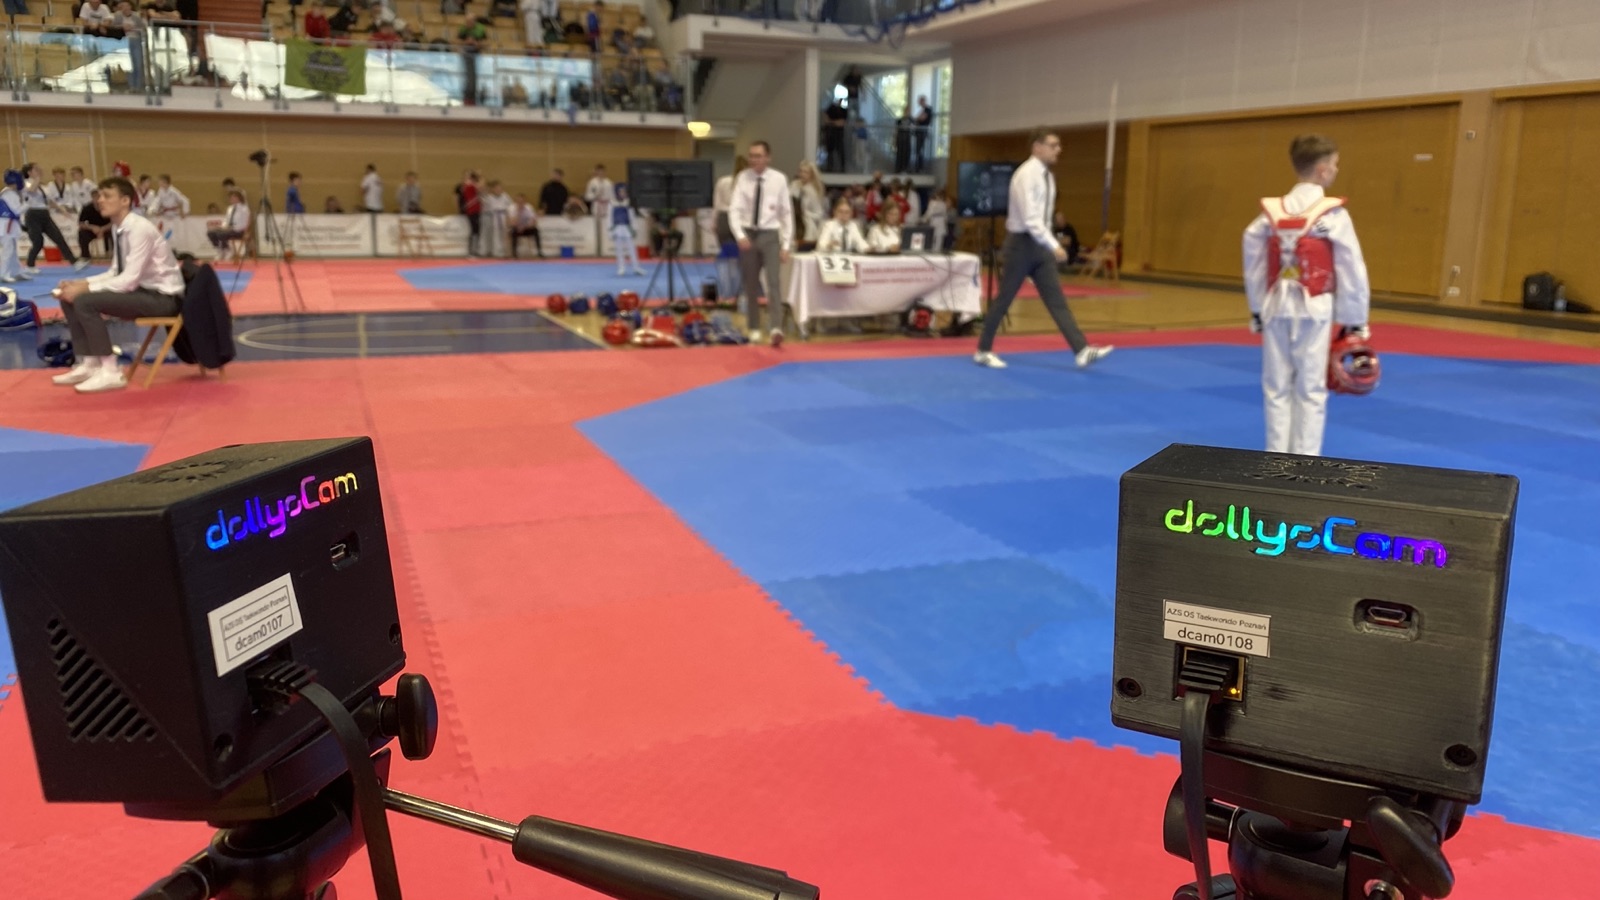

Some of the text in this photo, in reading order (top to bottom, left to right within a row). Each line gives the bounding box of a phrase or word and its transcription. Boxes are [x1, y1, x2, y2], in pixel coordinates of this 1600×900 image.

[823, 257, 835, 270] 3
[841, 258, 852, 271] 2
[1167, 608, 1183, 617] AZS
[1196, 612, 1237, 625] Taekwondo
[235, 614, 283, 651] dcam0107
[1177, 627, 1253, 650] dcam0108
